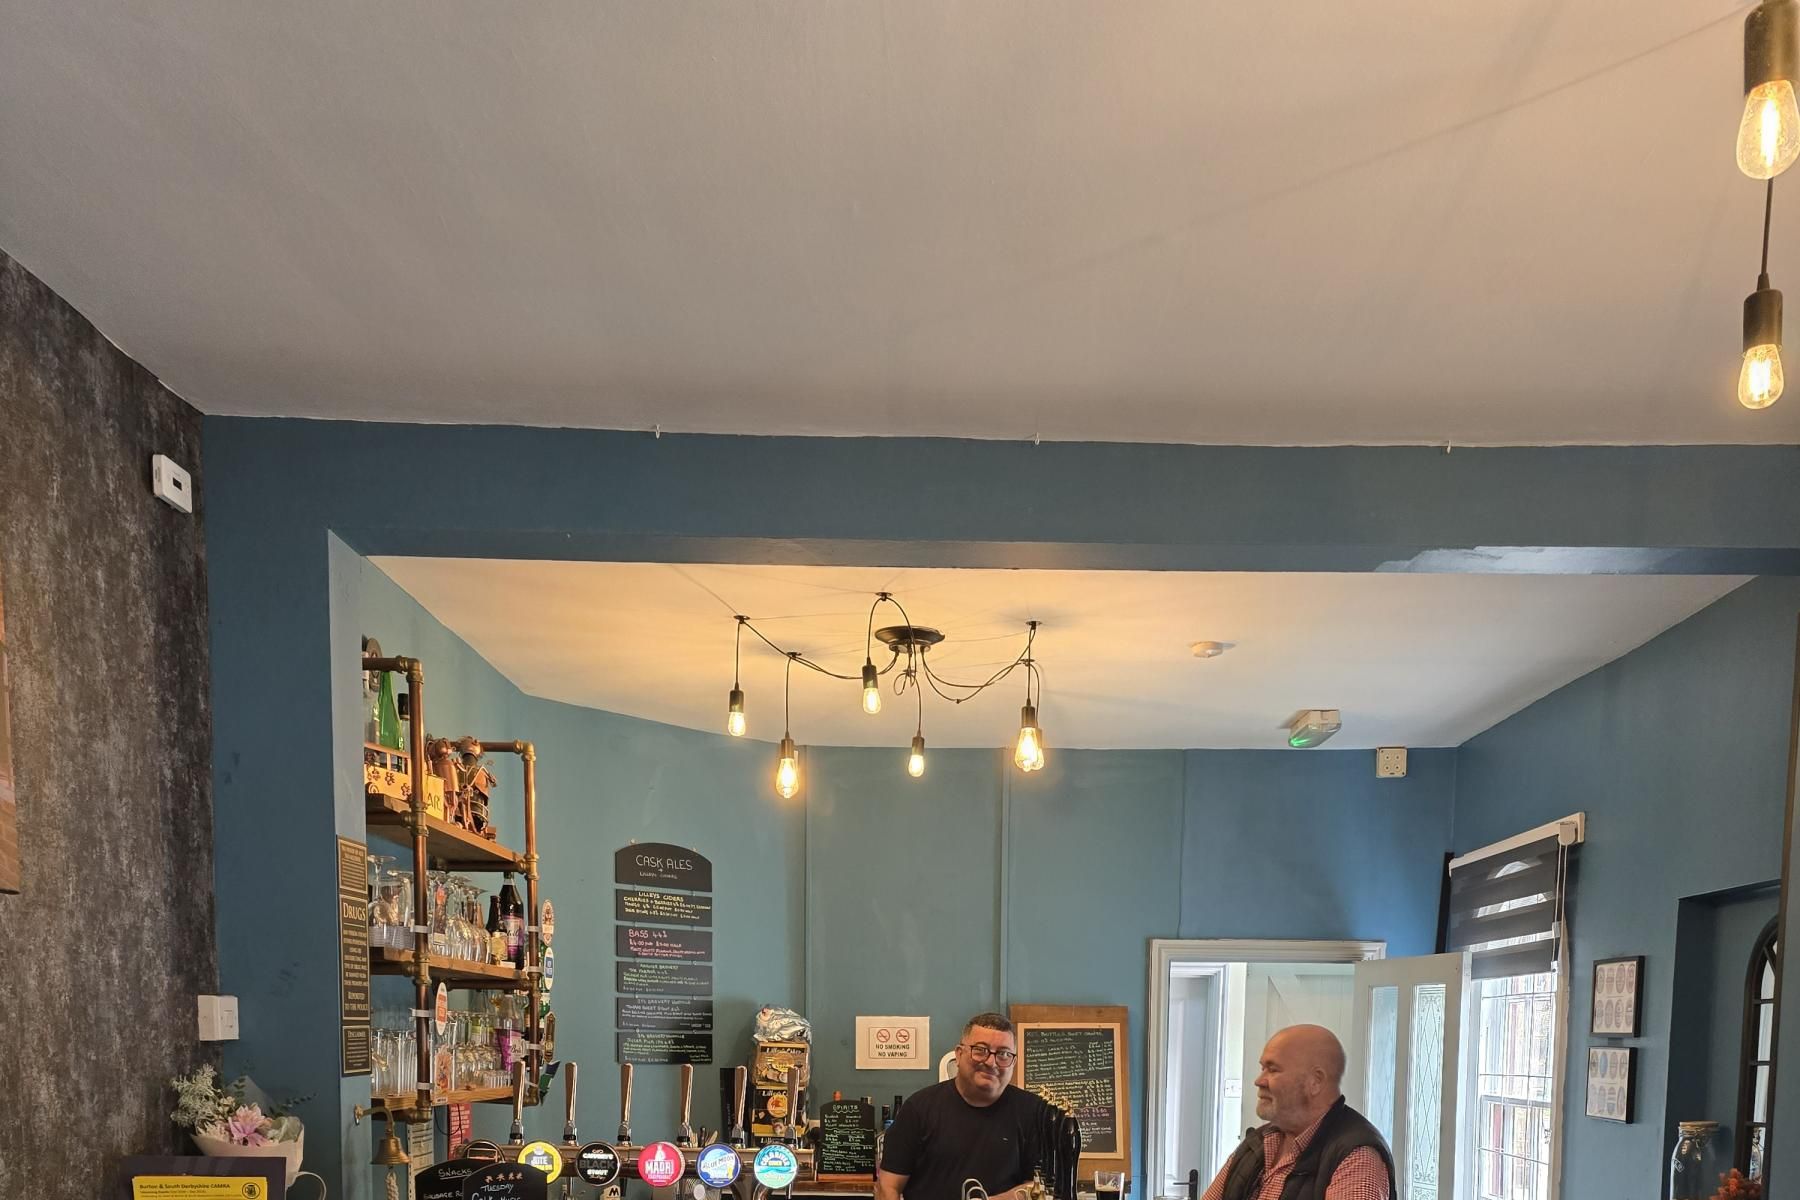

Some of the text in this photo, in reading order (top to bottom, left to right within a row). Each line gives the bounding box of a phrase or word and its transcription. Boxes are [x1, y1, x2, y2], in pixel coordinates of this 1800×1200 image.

[635, 854, 694, 871] CASK ALES
[638, 891, 685, 903] LILLEYS CIDERS
[343, 902, 366, 921] DRUGS
[628, 928, 649, 939] BASS
[579, 1160, 616, 1169] BLACK
[438, 1168, 473, 1178] SNACKS
[182, 1183, 210, 1191] Derbyshire
[480, 1184, 514, 1193] TUESDAY
